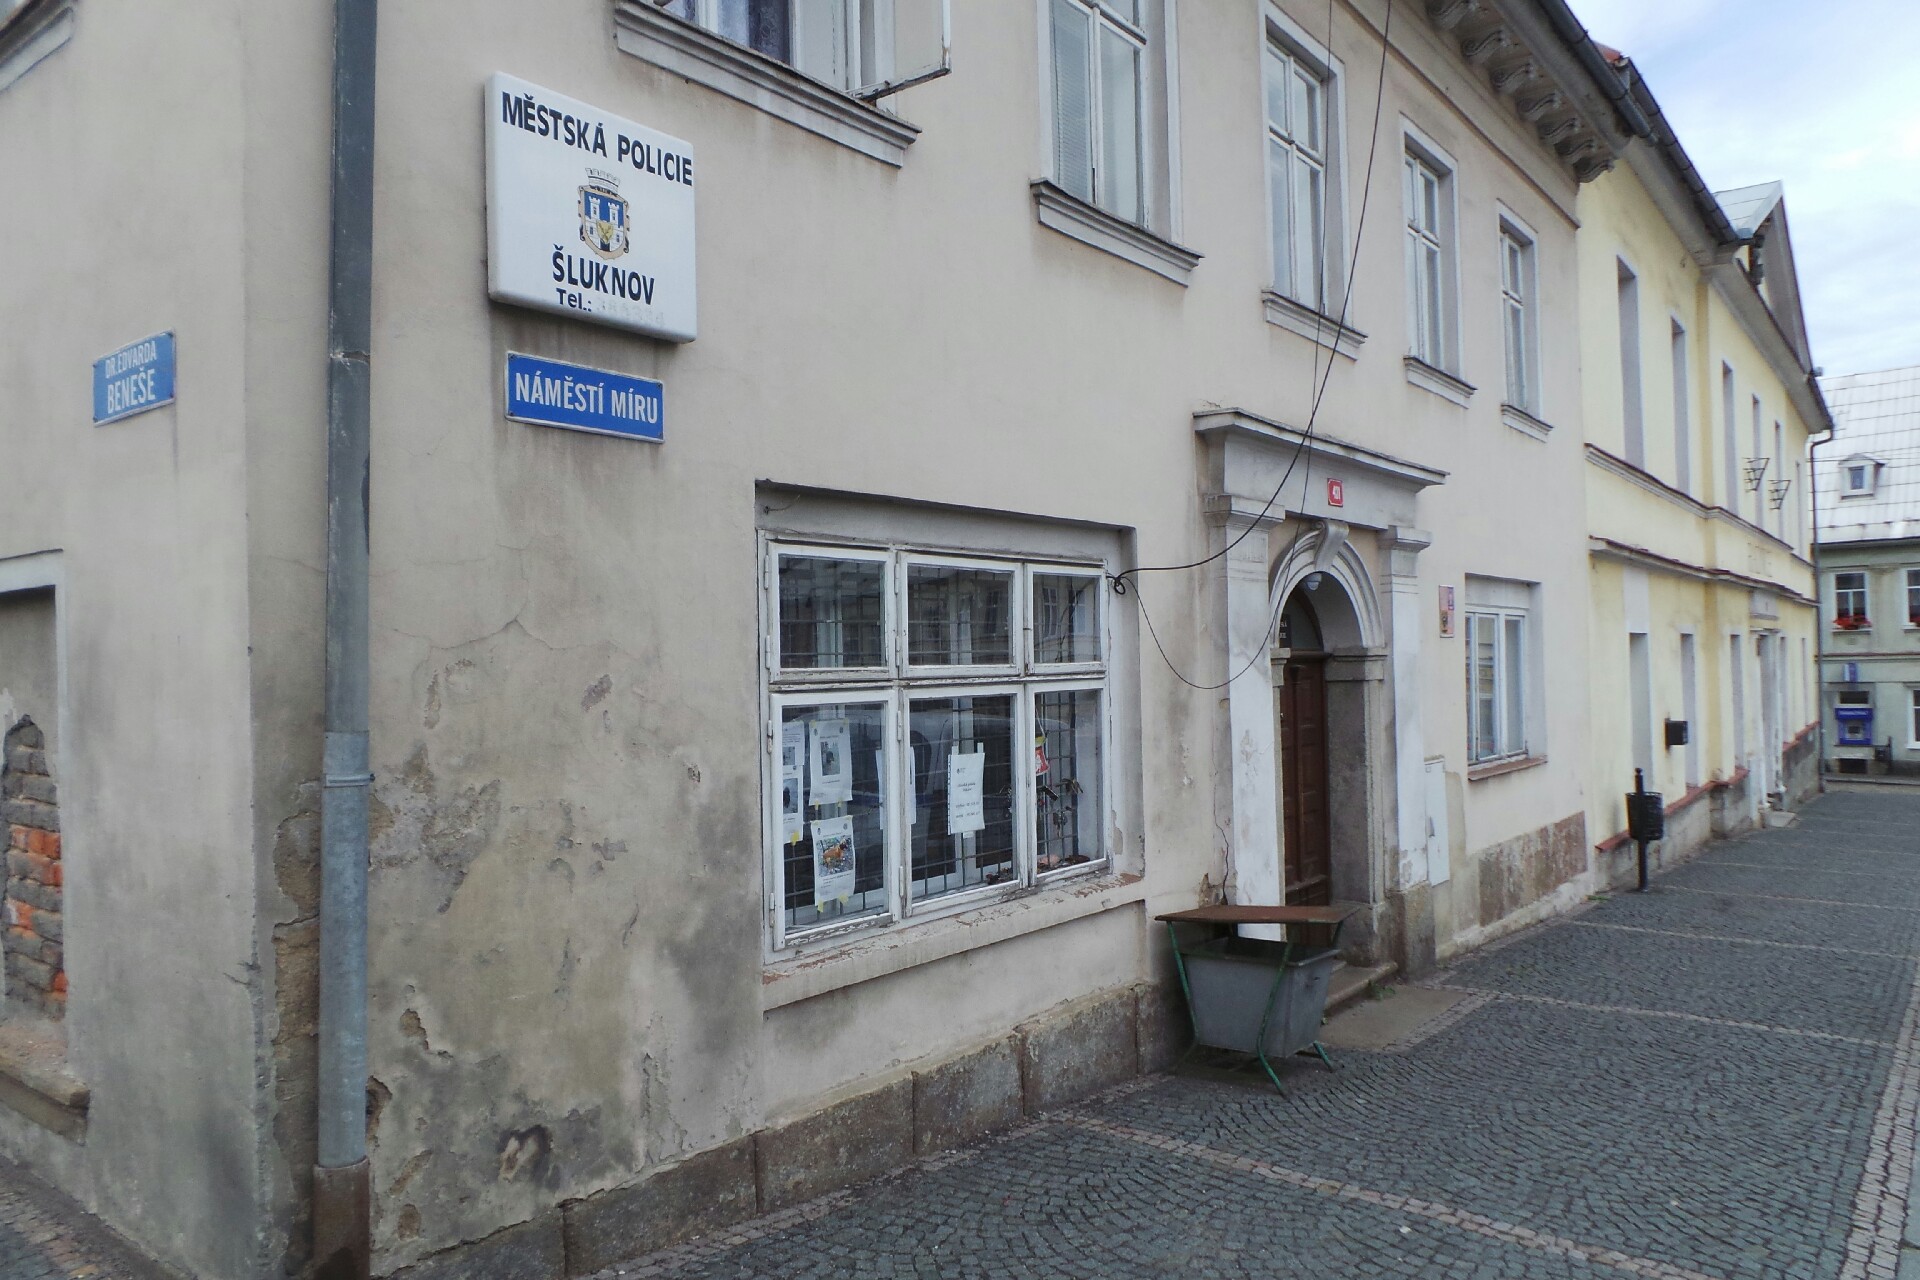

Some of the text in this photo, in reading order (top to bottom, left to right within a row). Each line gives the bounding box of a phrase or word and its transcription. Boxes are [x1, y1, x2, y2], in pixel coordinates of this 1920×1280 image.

[502, 90, 693, 187] MĚSTSKÁ POLICIE
[552, 243, 655, 306] ŠLUKNOV
[556, 287, 592, 312] Tel.:
[107, 365, 156, 414] BENEŠE
[515, 370, 658, 424] NÁMĚSTÍ MÍRU
